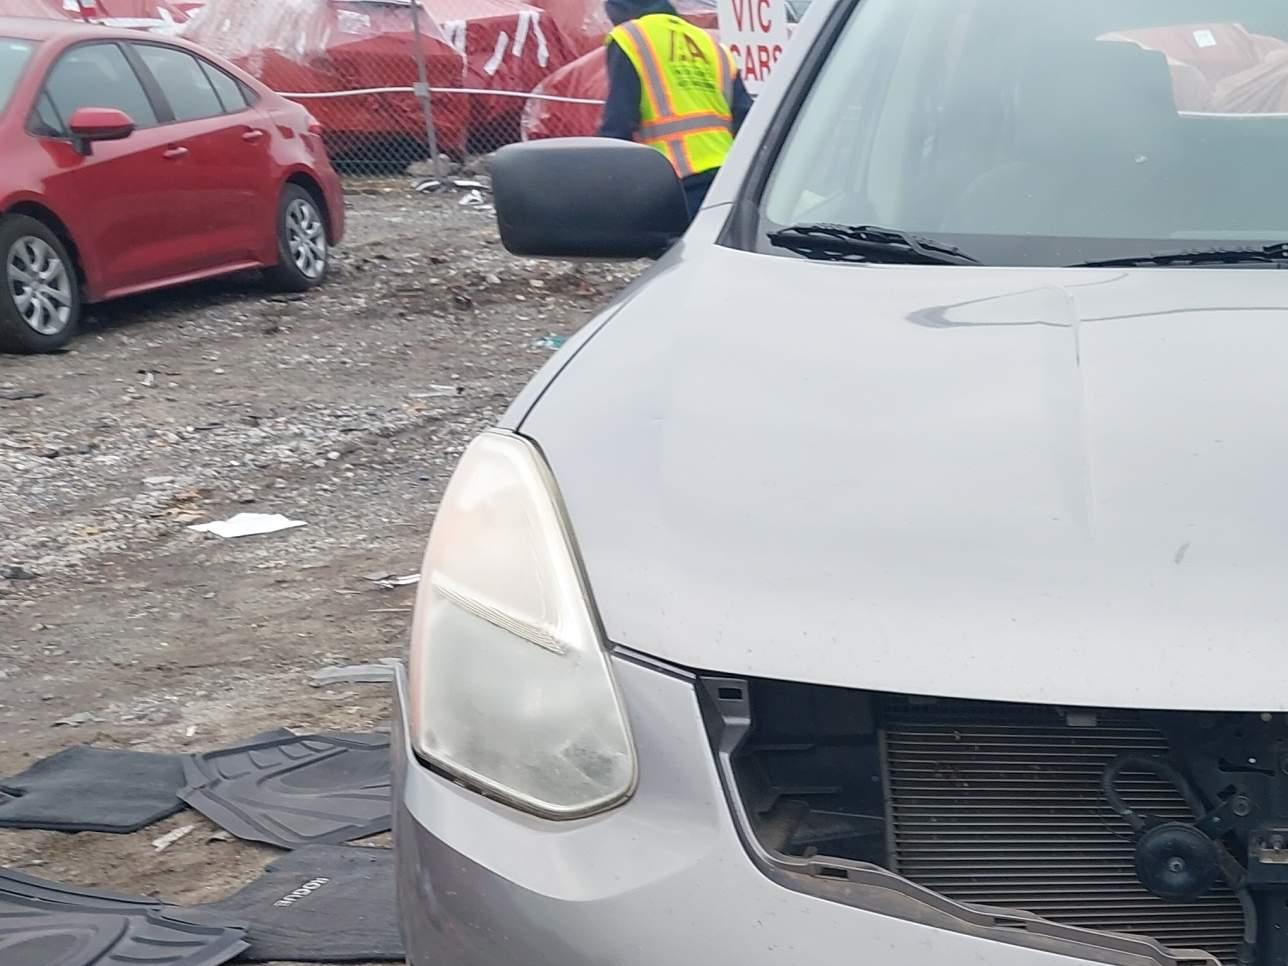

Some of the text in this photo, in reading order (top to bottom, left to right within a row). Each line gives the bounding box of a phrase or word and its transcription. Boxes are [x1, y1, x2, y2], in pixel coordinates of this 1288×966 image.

[731, 0, 772, 33] VIC
[668, 28, 710, 65] IA
[272, 876, 330, 907] ROGUE
